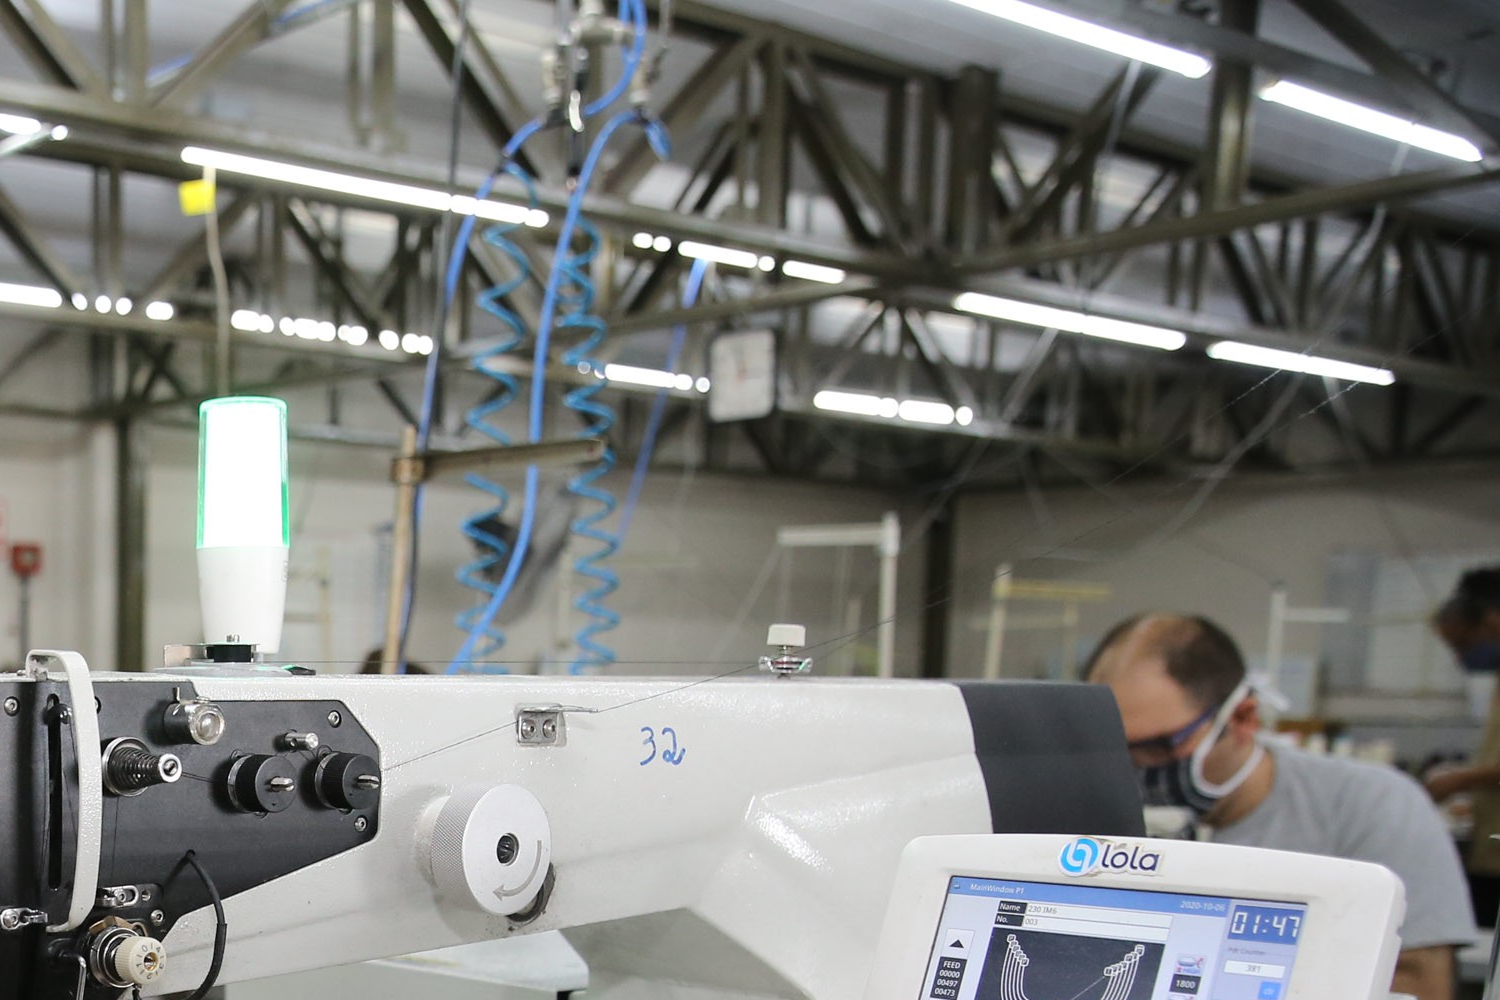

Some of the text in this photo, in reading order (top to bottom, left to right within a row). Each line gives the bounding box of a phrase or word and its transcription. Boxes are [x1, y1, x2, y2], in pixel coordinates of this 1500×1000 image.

[640, 726, 686, 766] 32
[1101, 844, 1160, 871] lola
[970, 883, 1014, 894] MainWindow
[1000, 902, 1021, 912] Name
[1028, 905, 1041, 914] 230
[997, 914, 1038, 926] No. 003
[1231, 911, 1300, 938] 01:47
[943, 960, 961, 969] FEED
[940, 969, 960, 978] 00000
[937, 978, 958, 988] 00497
[1176, 979, 1196, 989] 1800
[934, 987, 956, 997] 00473
